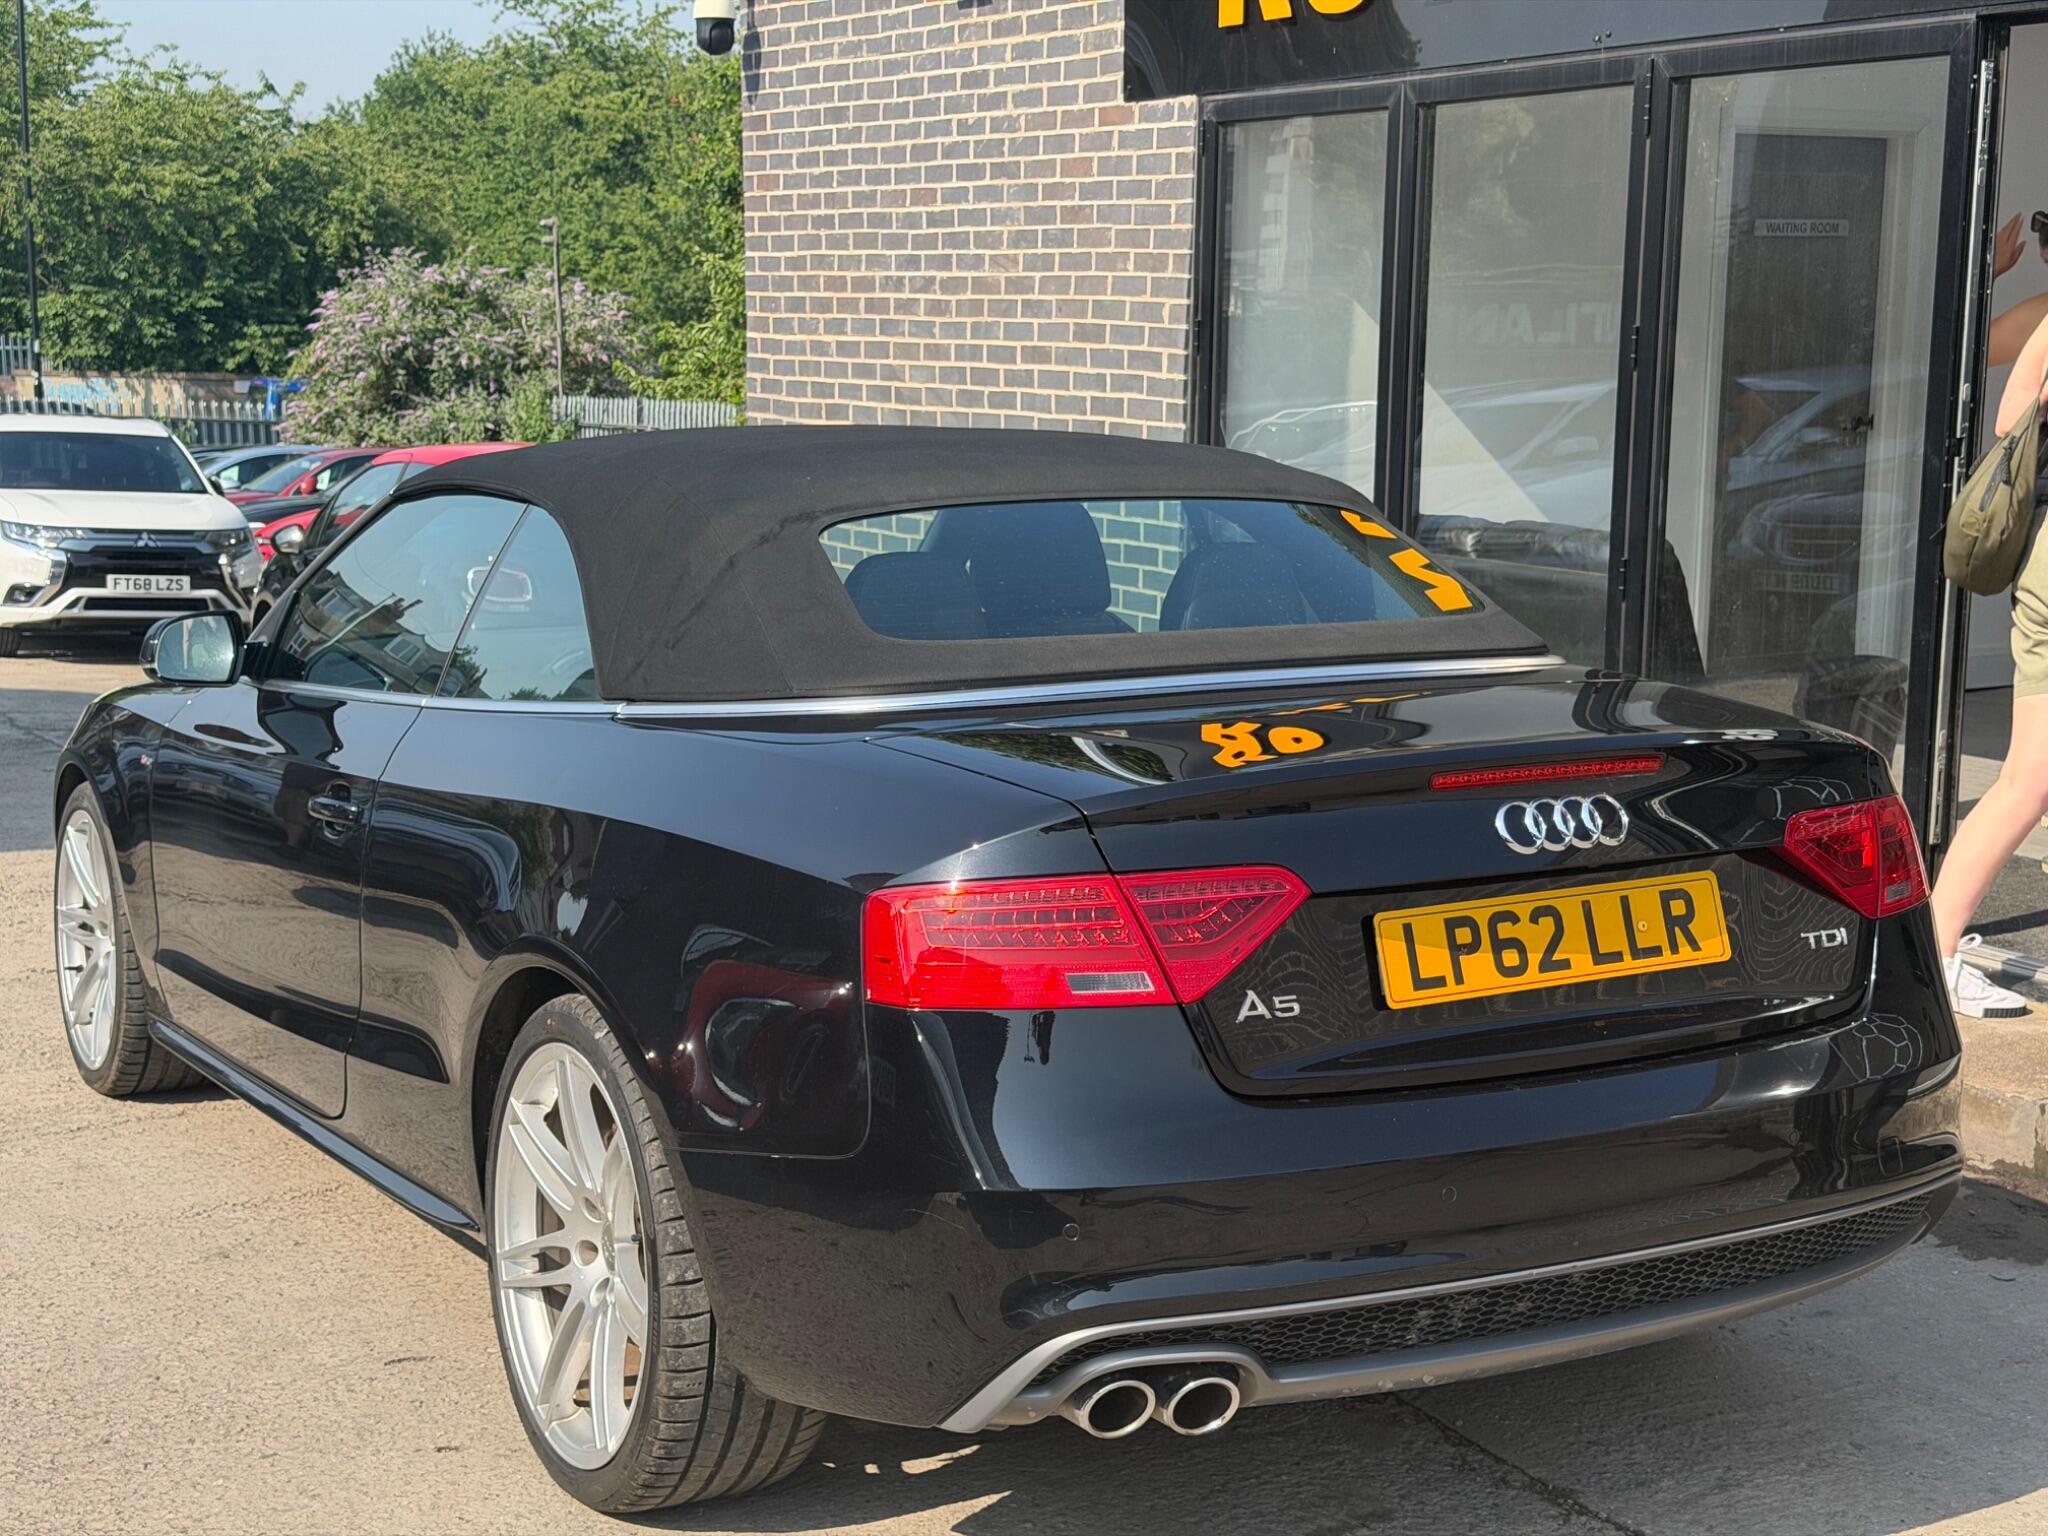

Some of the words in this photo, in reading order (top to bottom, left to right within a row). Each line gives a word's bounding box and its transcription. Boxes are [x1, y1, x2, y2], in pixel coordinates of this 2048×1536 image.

[1766, 222, 1807, 234] WAITING
[1810, 222, 1840, 234] ROOM
[113, 577, 152, 591] FT68
[156, 578, 184, 591] LZS
[1401, 904, 1572, 992] LP62
[1581, 887, 1703, 967] LLR
[1800, 926, 1848, 949] TDI
[1235, 989, 1301, 1024] A5
